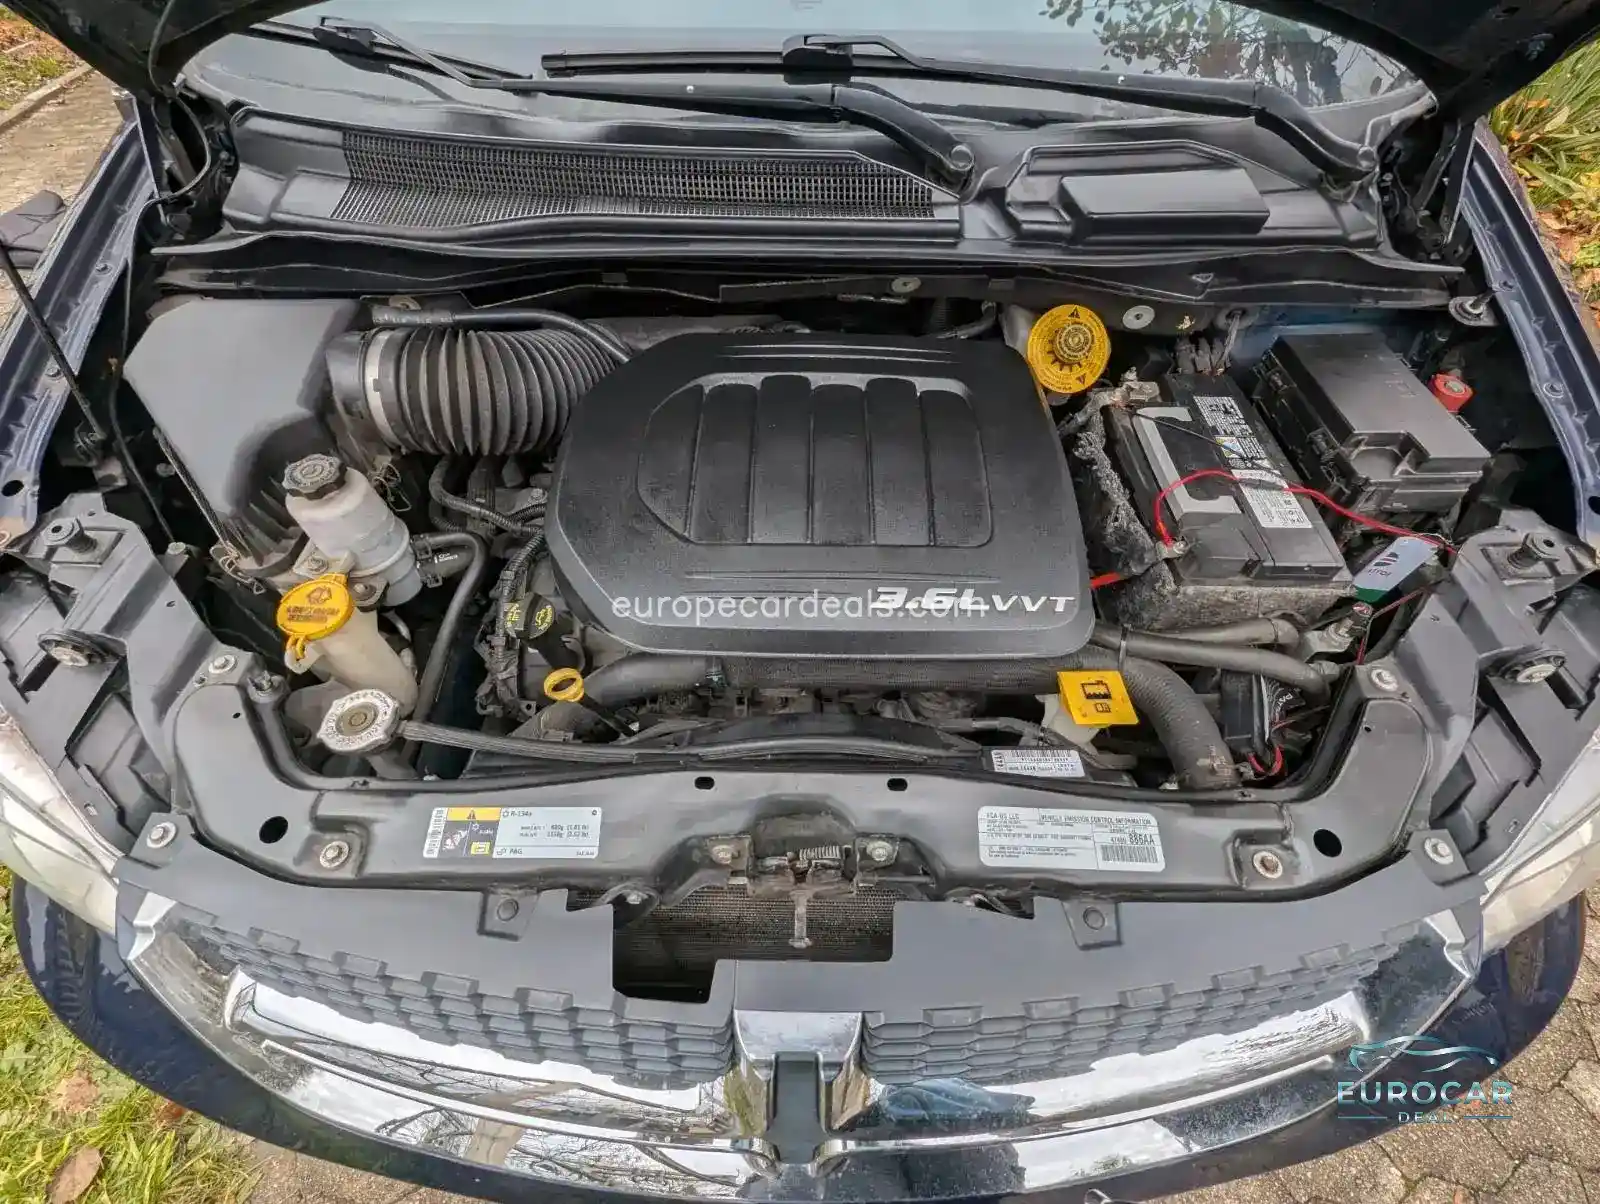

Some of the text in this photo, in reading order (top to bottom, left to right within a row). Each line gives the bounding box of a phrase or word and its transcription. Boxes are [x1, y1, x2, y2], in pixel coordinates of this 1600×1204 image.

[1041, 814, 1153, 825] VEHICLE EMISSION CONTROL INFORMATION
